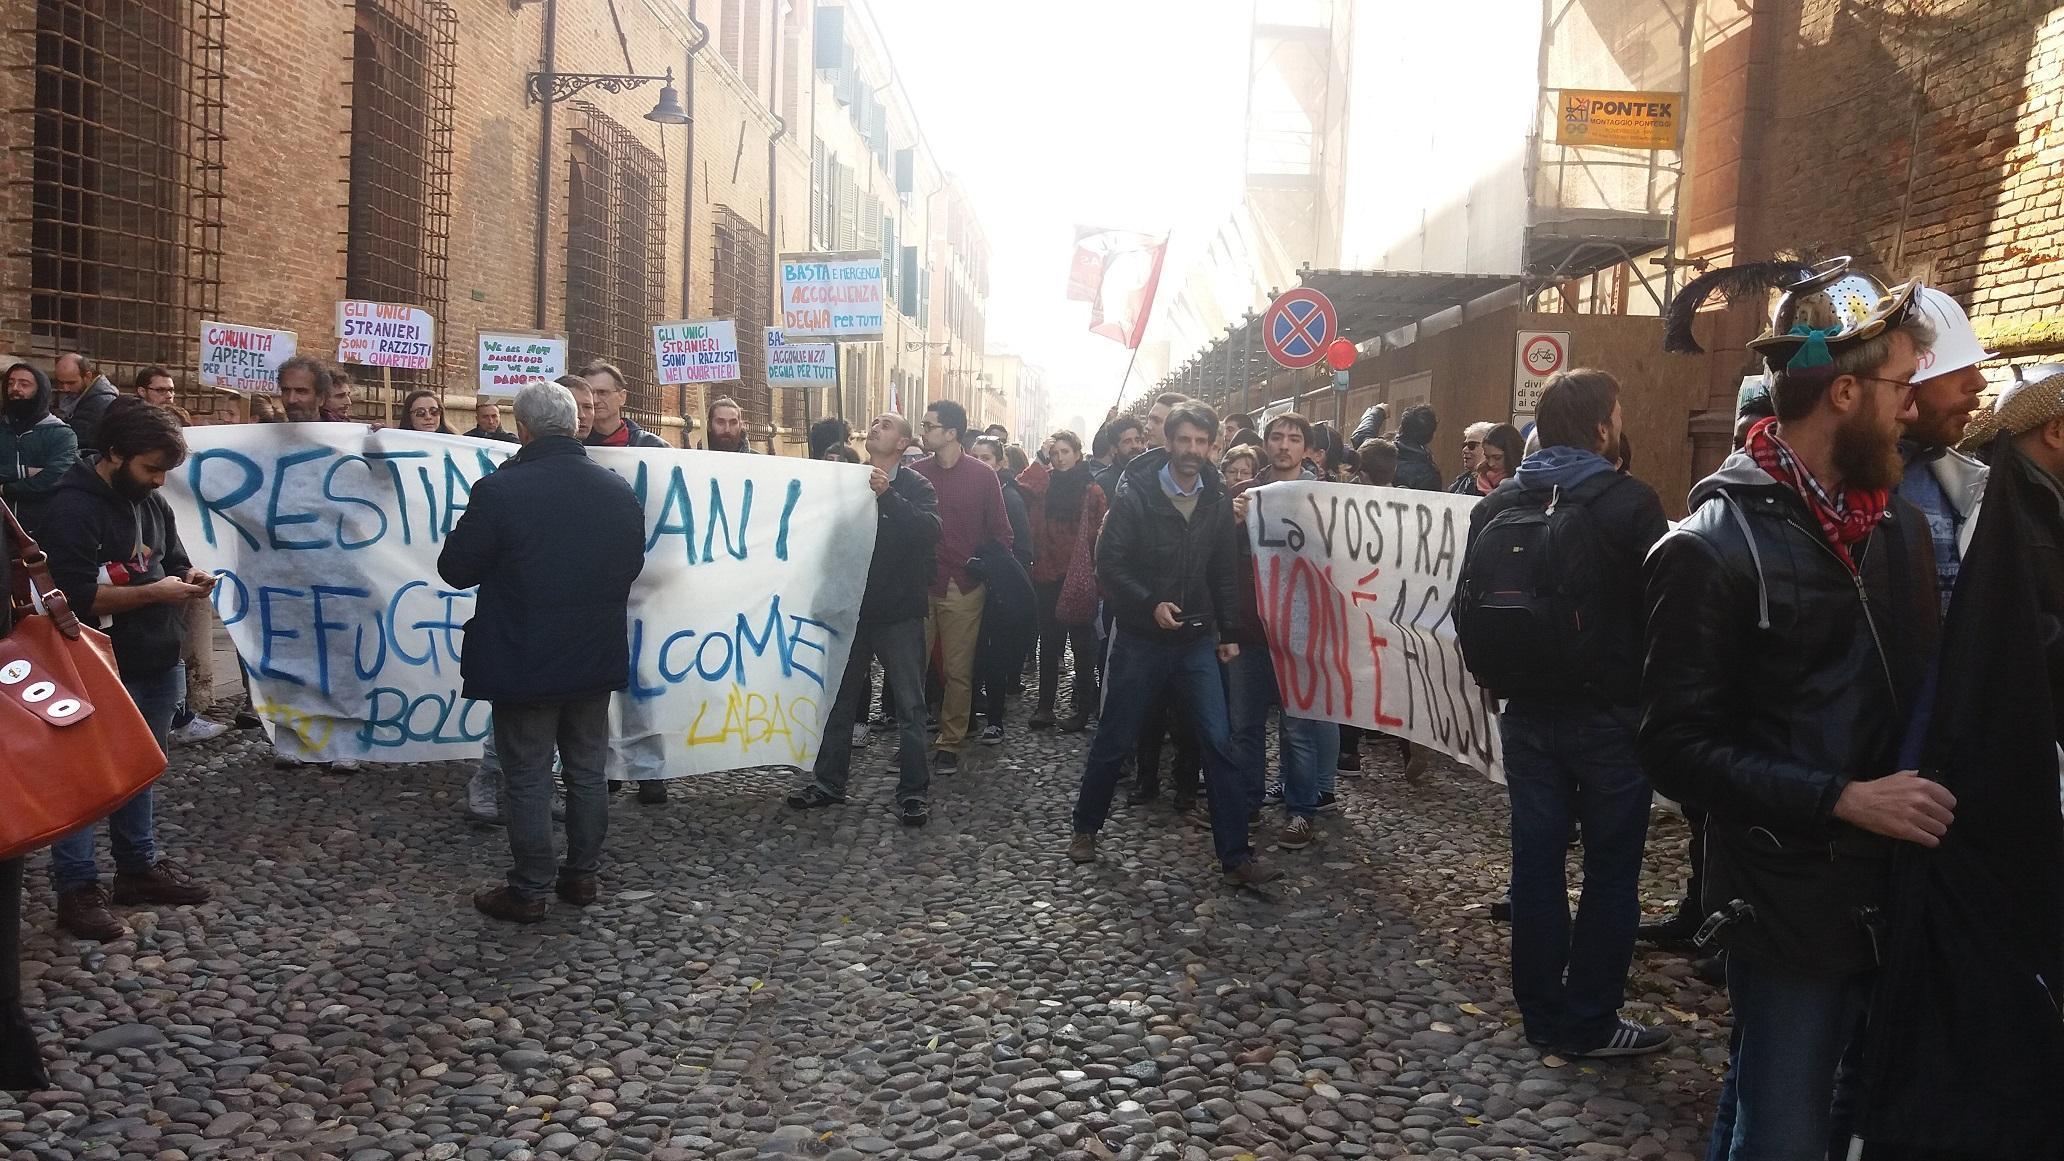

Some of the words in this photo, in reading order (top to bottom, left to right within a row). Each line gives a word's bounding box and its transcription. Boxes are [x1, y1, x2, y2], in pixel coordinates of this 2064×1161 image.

[1591, 100, 1672, 118] PONTEK
[1590, 118, 1633, 126] MONTAGGIO
[785, 264, 830, 281] BASTA
[791, 285, 879, 305] ACCOGLIENZA
[344, 303, 368, 317] GLI
[376, 304, 412, 321] UNICI
[786, 309, 831, 331] DEGNA
[855, 315, 882, 328] TUTTI
[344, 319, 420, 340] STRANIERI
[658, 327, 675, 341] GLI
[682, 326, 708, 340] UNICI
[342, 338, 368, 349] SONO
[379, 339, 431, 357] RAZZISTI
[662, 338, 720, 354] STRANIERI
[768, 331, 785, 347] BAS
[211, 346, 265, 368] APERTE
[368, 352, 429, 369] QUARTIERI
[488, 354, 543, 363] DANGEROUS
[662, 353, 686, 367] SONO
[698, 349, 738, 365] RAZZISTI
[772, 349, 826, 364] ACCOGLIENZA
[203, 362, 220, 375] PER
[225, 364, 238, 377] LE
[664, 367, 682, 381] NEI
[687, 364, 736, 380] QUARTIERI
[768, 365, 795, 379] DEGNA
[797, 363, 811, 378] PER
[813, 365, 836, 379] TUTT
[216, 376, 233, 387] DEL
[1524, 380, 1542, 388] divi
[1517, 389, 1526, 397] di
[1518, 399, 1527, 407] ai
[1308, 493, 1455, 581] VOSTRA
[209, 568, 478, 697] REFUGE
[629, 593, 839, 704] LCOME
[1253, 555, 1353, 719] NON
[356, 687, 492, 754] BOLO
